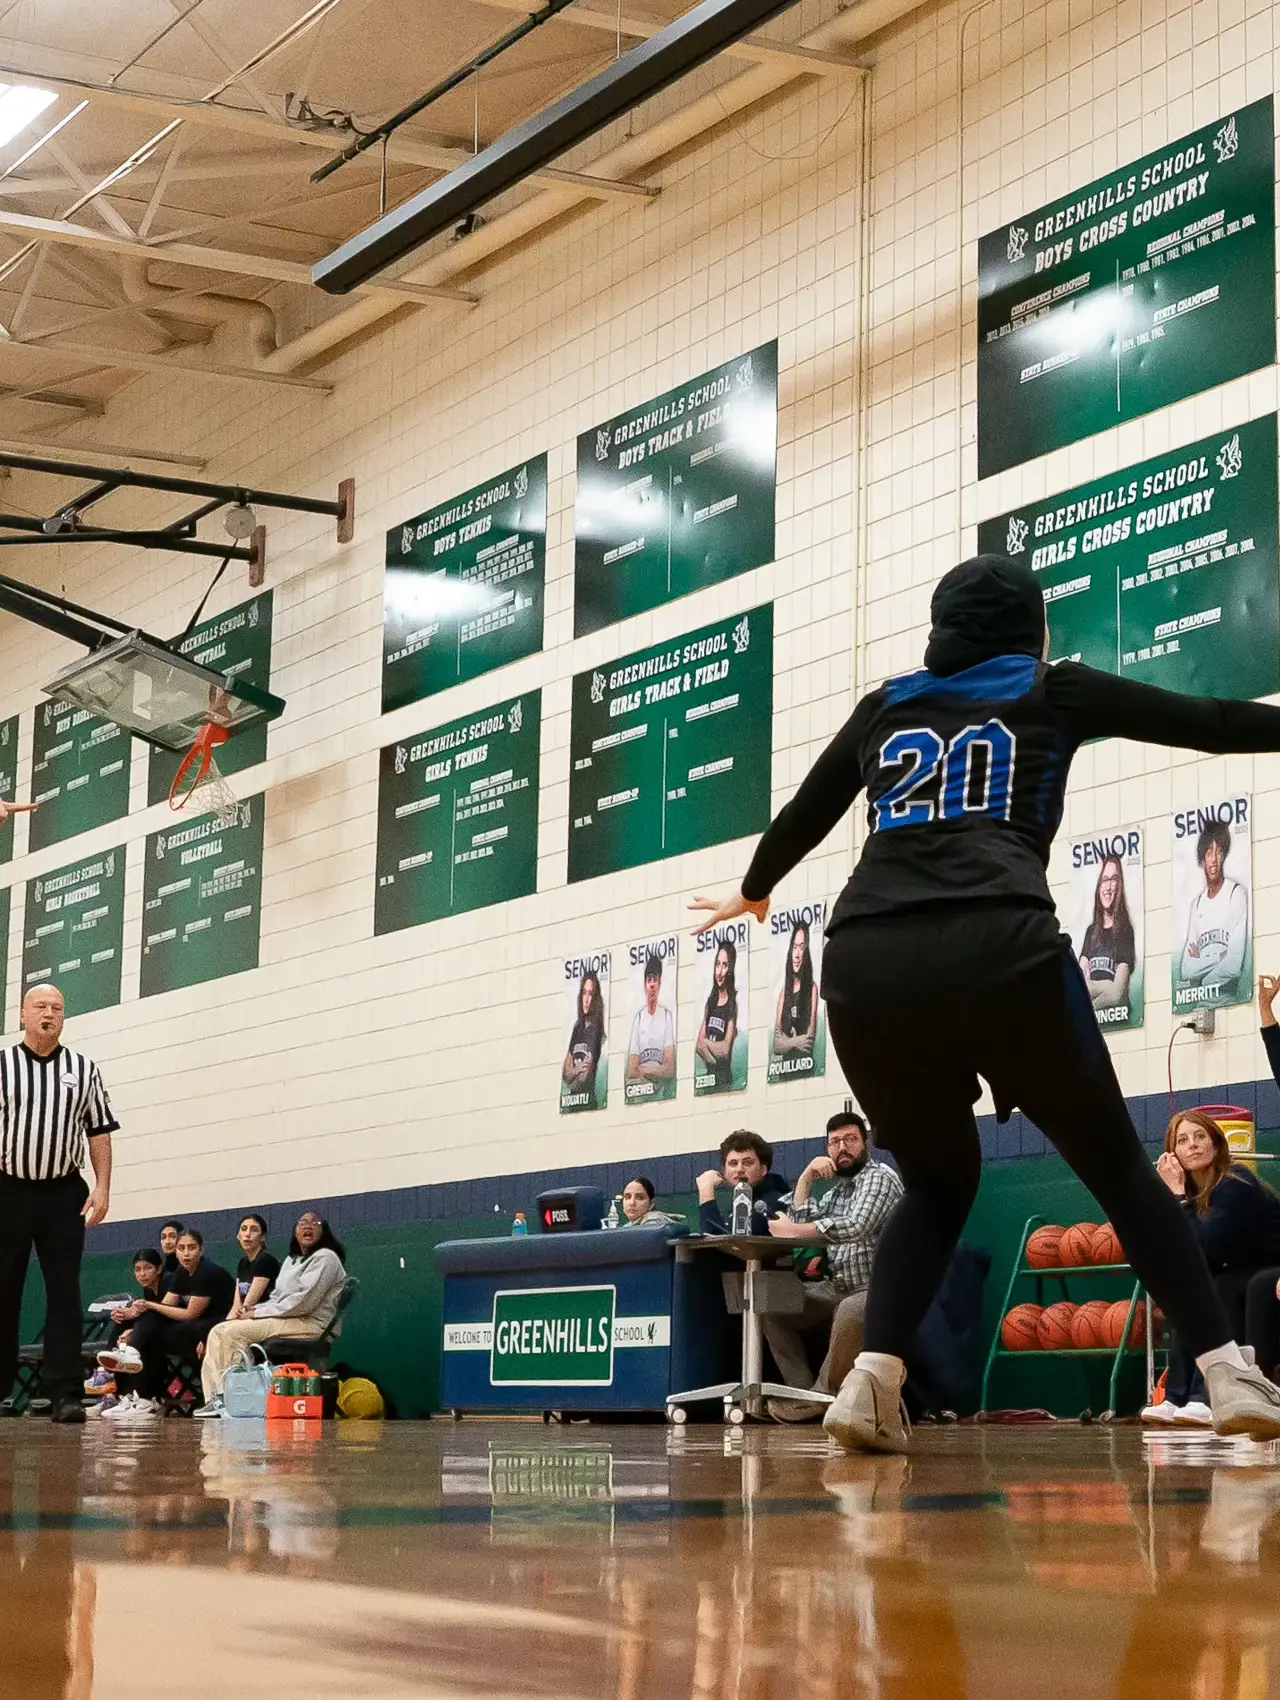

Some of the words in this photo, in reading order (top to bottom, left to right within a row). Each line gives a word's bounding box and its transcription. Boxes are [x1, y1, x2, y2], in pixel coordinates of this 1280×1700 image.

[1034, 175, 1137, 242] GREENHILLS
[1140, 142, 1206, 191] SCHOOL
[1034, 237, 1073, 274] BOYS
[1078, 211, 1128, 253] CROSS
[1132, 171, 1210, 228] COUNTRY
[614, 397, 685, 445] GREENHILLS
[687, 374, 731, 411] SCHOOL
[618, 441, 646, 470] BOYS
[648, 423, 684, 456] TRACK
[685, 419, 693, 439] &
[696, 401, 731, 434] FIELD
[416, 499, 474, 541] GREENHILLS
[475, 481, 511, 512] SCHOOL
[1034, 481, 1138, 538] GREENHILLS
[1142, 456, 1209, 499] SCHOOL
[433, 531, 457, 556] BOYS
[458, 514, 492, 544] TENNIS
[1031, 535, 1077, 572] GIRLS
[1082, 516, 1132, 554] CROSS
[1135, 487, 1215, 535] COUNTRY
[609, 648, 681, 690] GREENHILLS
[682, 632, 728, 664] SCHOOL
[609, 690, 642, 718] GIRLS
[644, 675, 682, 705] TRACK
[683, 672, 691, 692] &
[694, 658, 730, 688] FIELD
[410, 727, 468, 762] GREENHILLS
[469, 713, 505, 741] SCHOOL
[425, 759, 452, 783] GIRLS
[454, 743, 489, 770] TENNIS
[873, 717, 1016, 834] 20
[1174, 798, 1248, 839] SENIOR
[1072, 831, 1140, 869] SENIOR
[696, 922, 746, 953] SENIOR
[770, 903, 822, 935] SENIOR
[564, 953, 608, 980] SENIOR
[629, 937, 676, 966] SENIOR
[1175, 984, 1220, 1005] MERRITT
[768, 1057, 814, 1076] ROUILLARD
[448, 1331, 481, 1344] WELCOME
[482, 1330, 492, 1343] TO
[496, 1316, 609, 1355] GREENHILLS
[614, 1327, 645, 1341] SCHOOL
[293, 1399, 307, 1415] G
